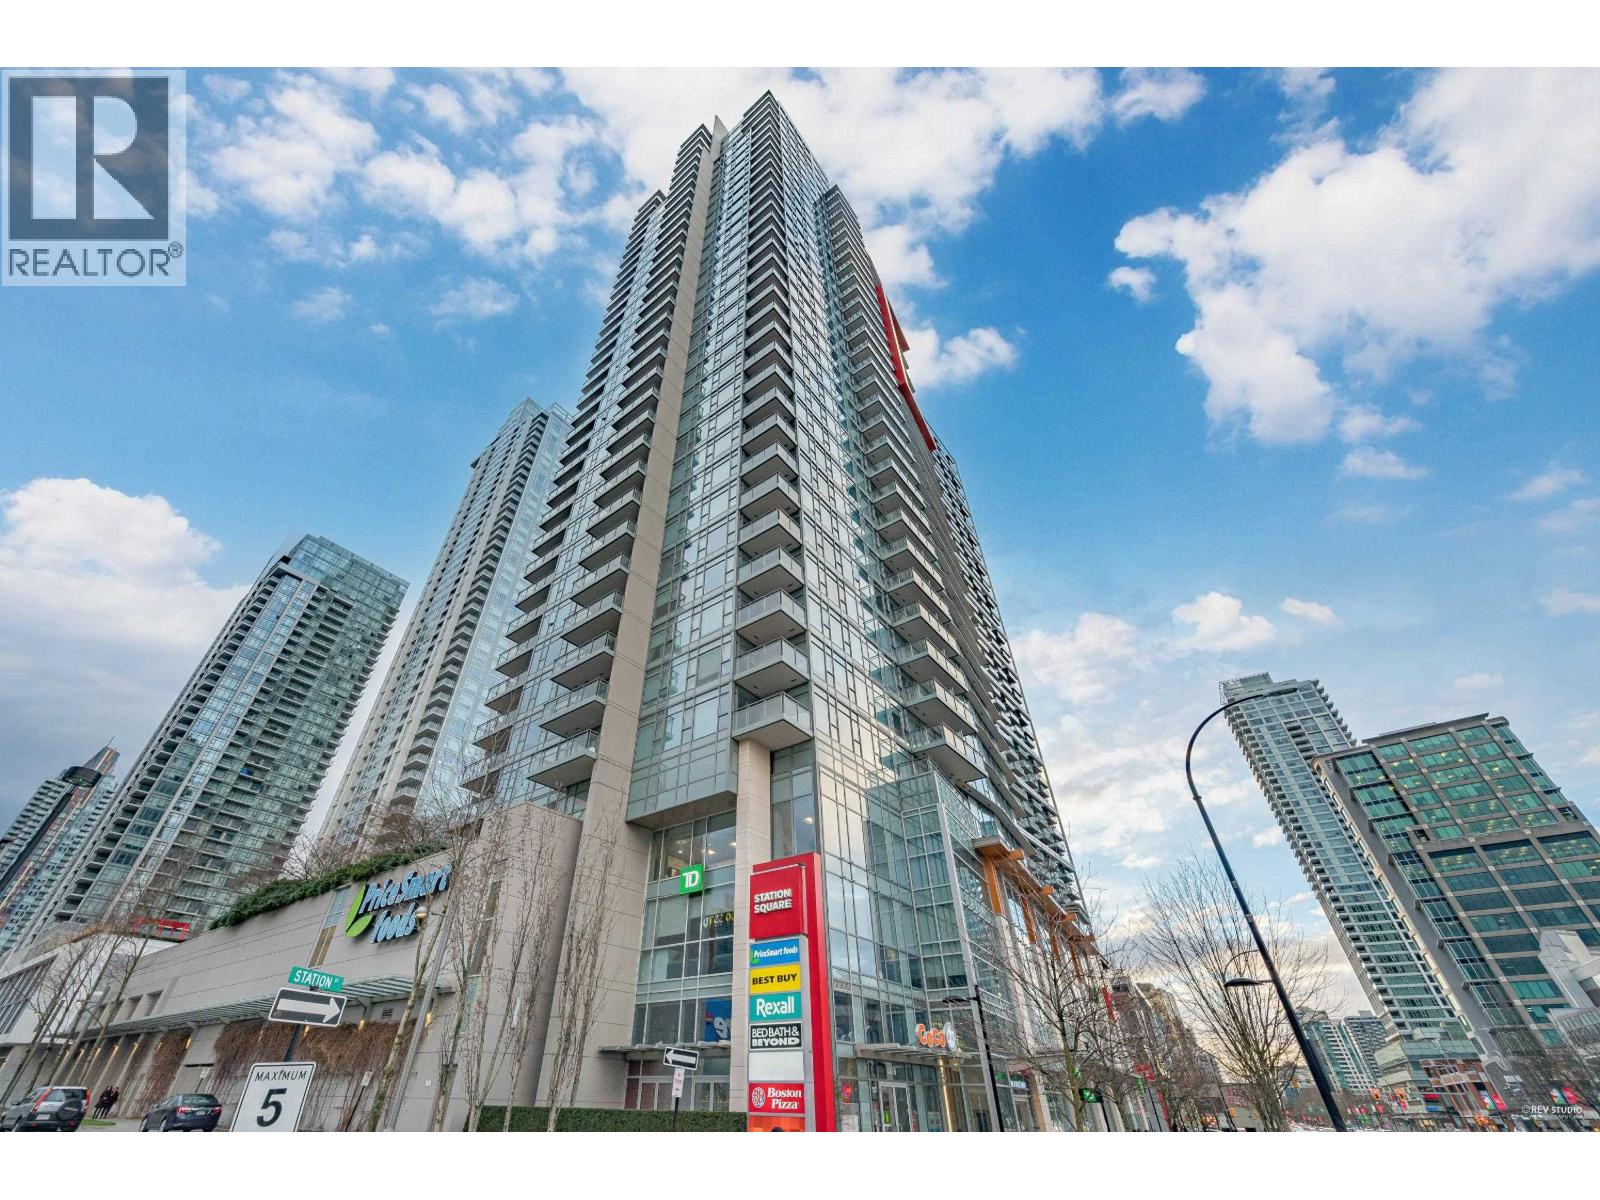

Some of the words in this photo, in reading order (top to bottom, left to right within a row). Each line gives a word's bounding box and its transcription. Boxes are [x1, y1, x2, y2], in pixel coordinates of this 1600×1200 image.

[682, 870, 700, 888] TD
[753, 888, 793, 903] STATION
[753, 899, 793, 914] SQUARE
[753, 948, 782, 959] PriceSmart
[783, 945, 799, 955] foods
[293, 969, 333, 989] STATION
[752, 975, 775, 986] BEST
[777, 973, 798, 983] BUY
[756, 995, 795, 1018] Rexall
[751, 1028, 768, 1039] BED
[769, 1026, 791, 1038] BATH
[791, 1025, 800, 1037] &
[751, 1037, 801, 1047] BEYOND
[254, 1069, 308, 1082] MAXIMUM
[767, 1087, 802, 1098] Boston
[256, 1087, 288, 1128] 5
[771, 1098, 799, 1110] Pizza
